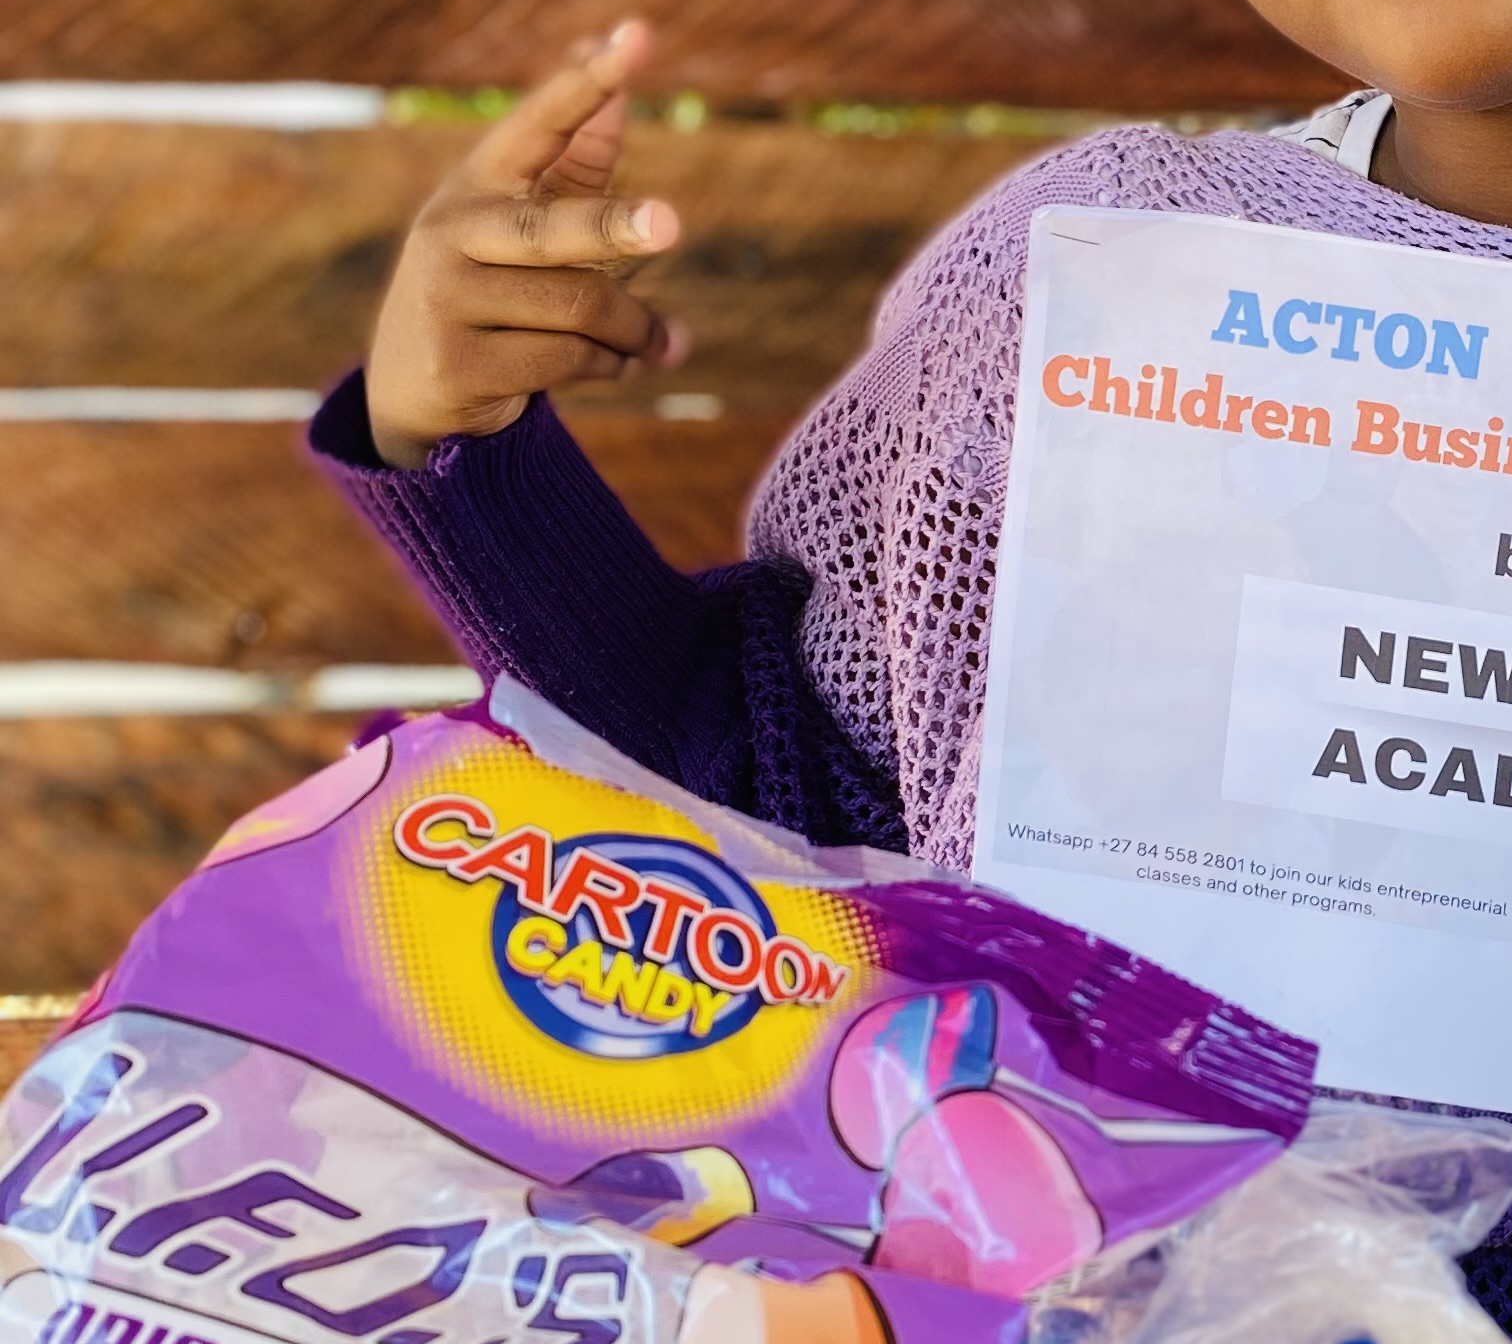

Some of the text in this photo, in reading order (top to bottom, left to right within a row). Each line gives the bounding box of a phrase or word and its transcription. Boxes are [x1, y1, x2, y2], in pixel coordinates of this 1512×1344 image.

[1210, 289, 1489, 380] ACTON
[1042, 354, 1331, 447] Children
[397, 795, 850, 1005] CARTOON
[1007, 822, 1508, 917] Whatsapp +27 84 558 2801 to join our kids entrepreneurial
[1136, 865, 1377, 918] classes and other programs.
[507, 916, 731, 1037] CANDY
